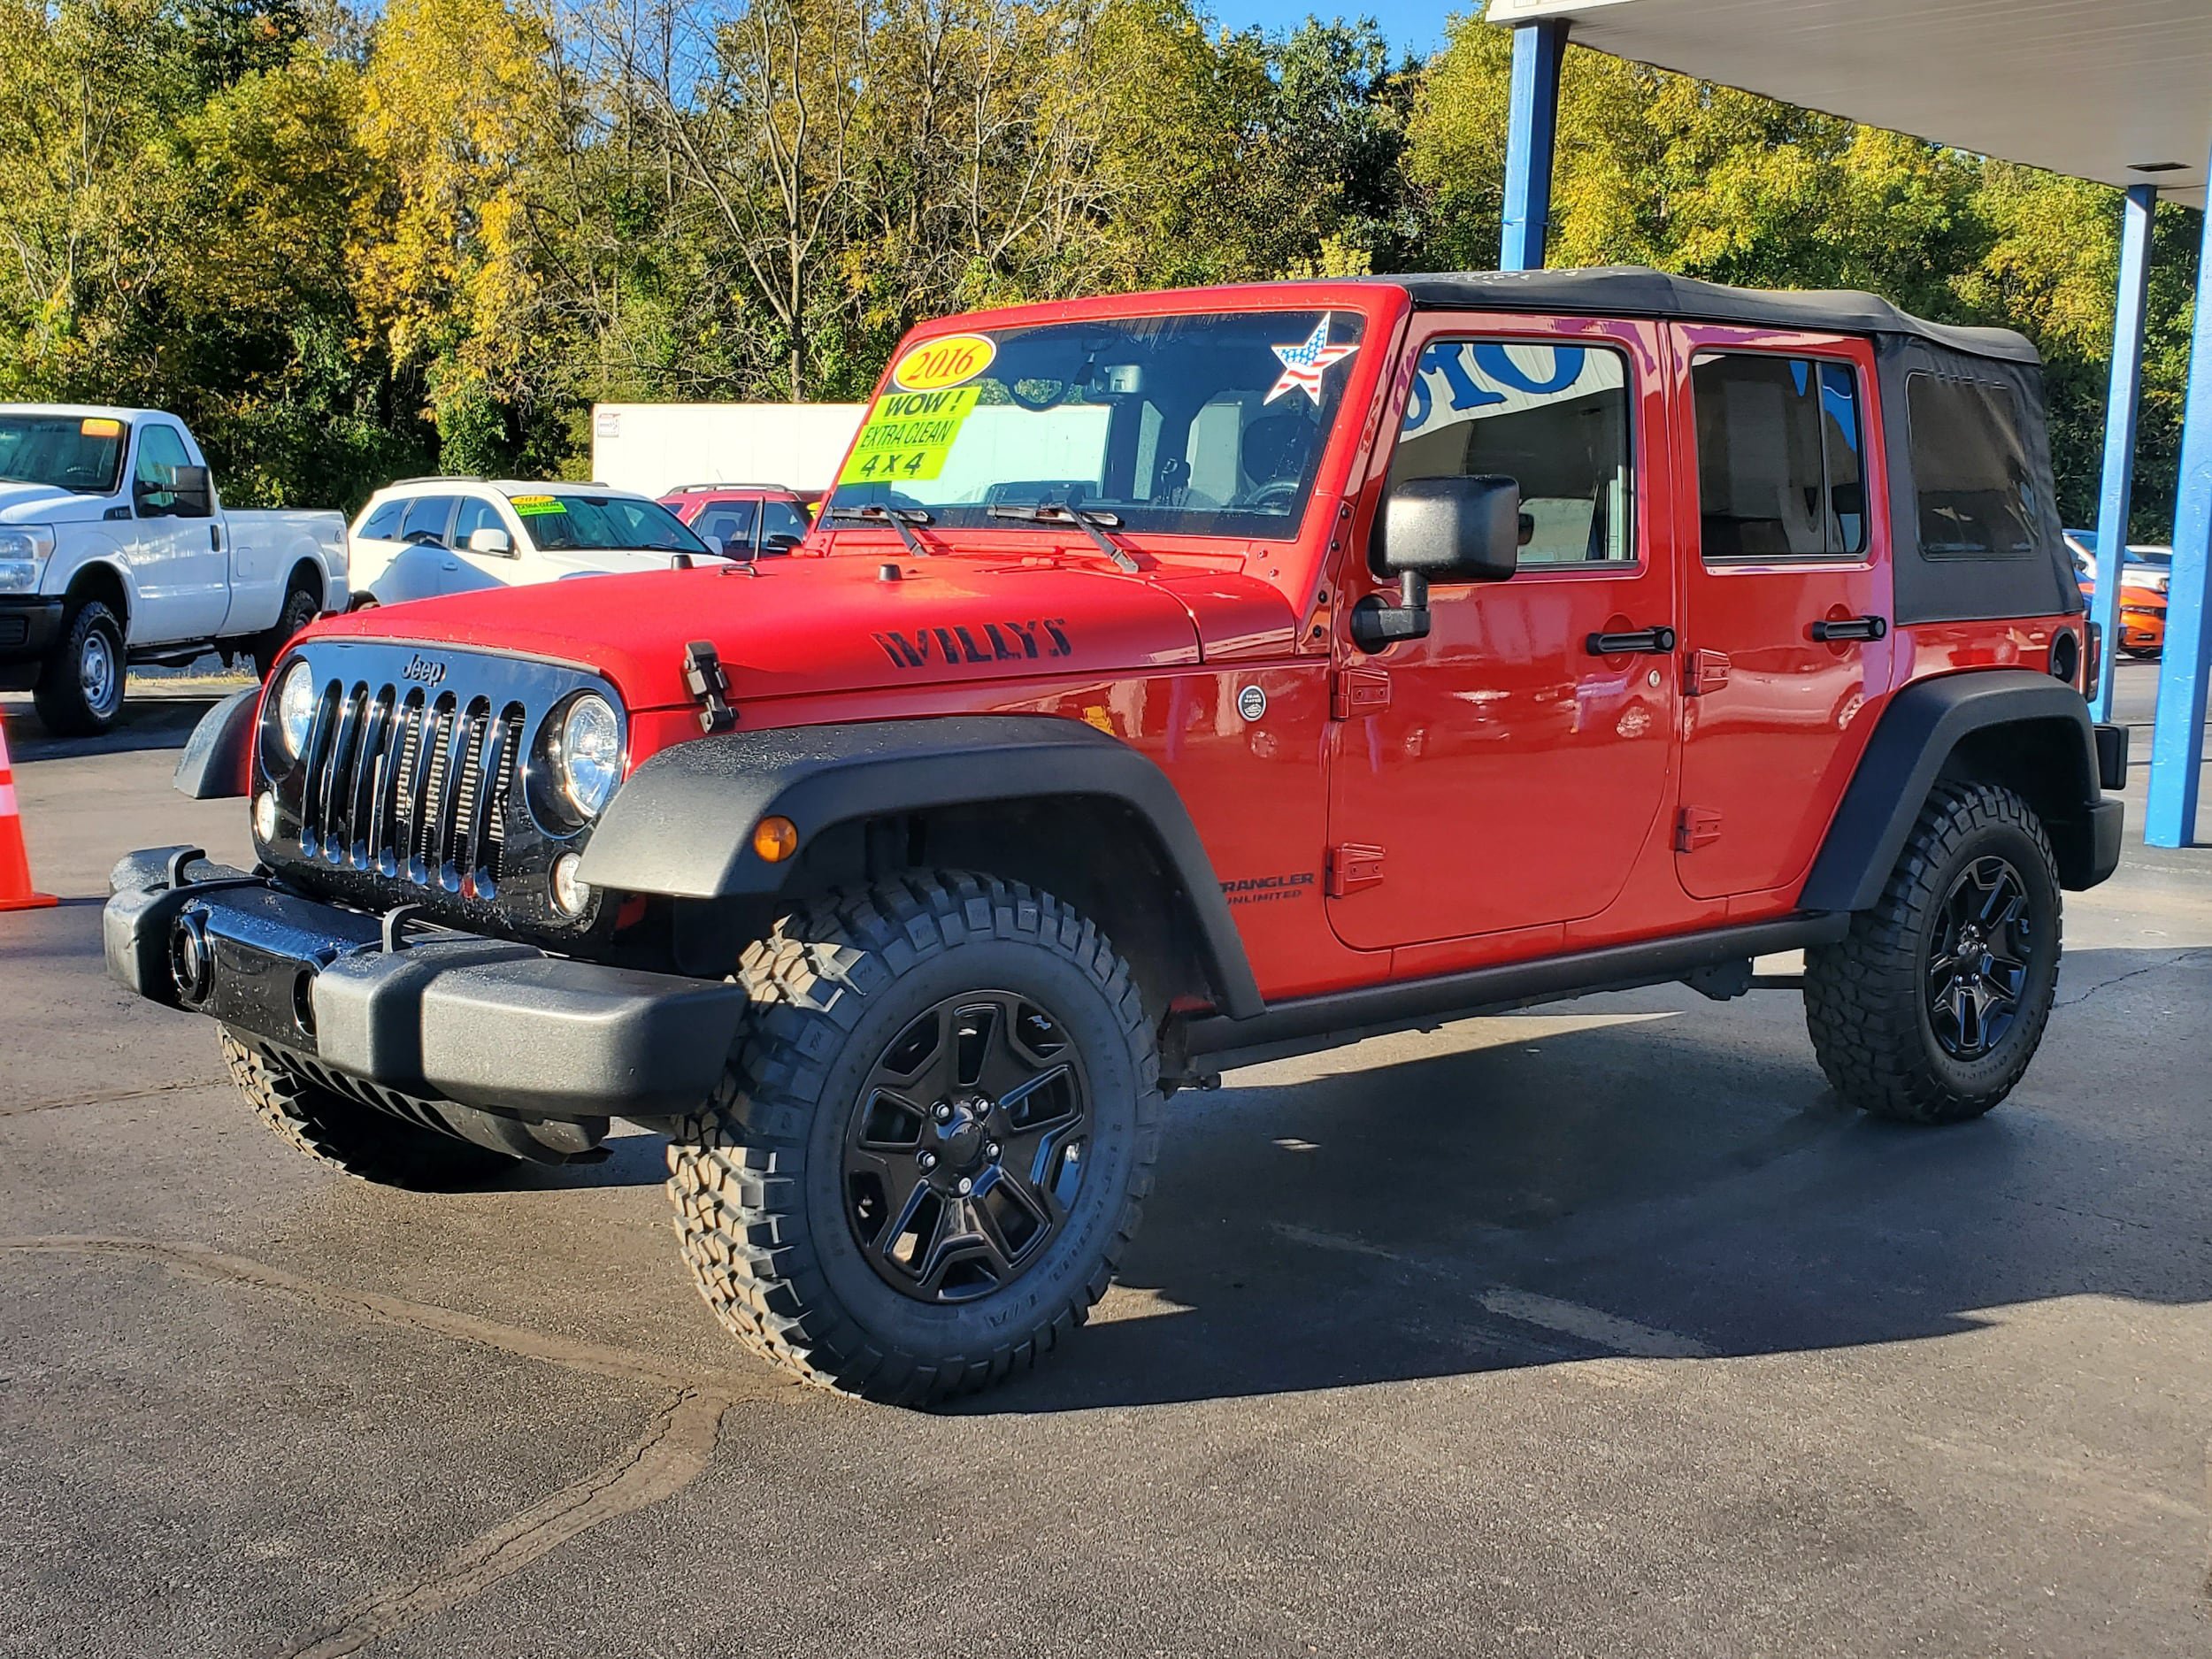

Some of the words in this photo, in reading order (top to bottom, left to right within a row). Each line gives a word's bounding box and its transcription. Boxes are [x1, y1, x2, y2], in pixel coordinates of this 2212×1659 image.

[905, 344, 982, 381] 2016
[884, 390, 953, 418] WOW
[860, 423, 905, 448] EXTRA
[903, 419, 955, 443] CLEAN
[871, 617, 1072, 669] WILLYS
[402, 653, 445, 687] Jeep
[1219, 872, 1314, 893] RANGLER
